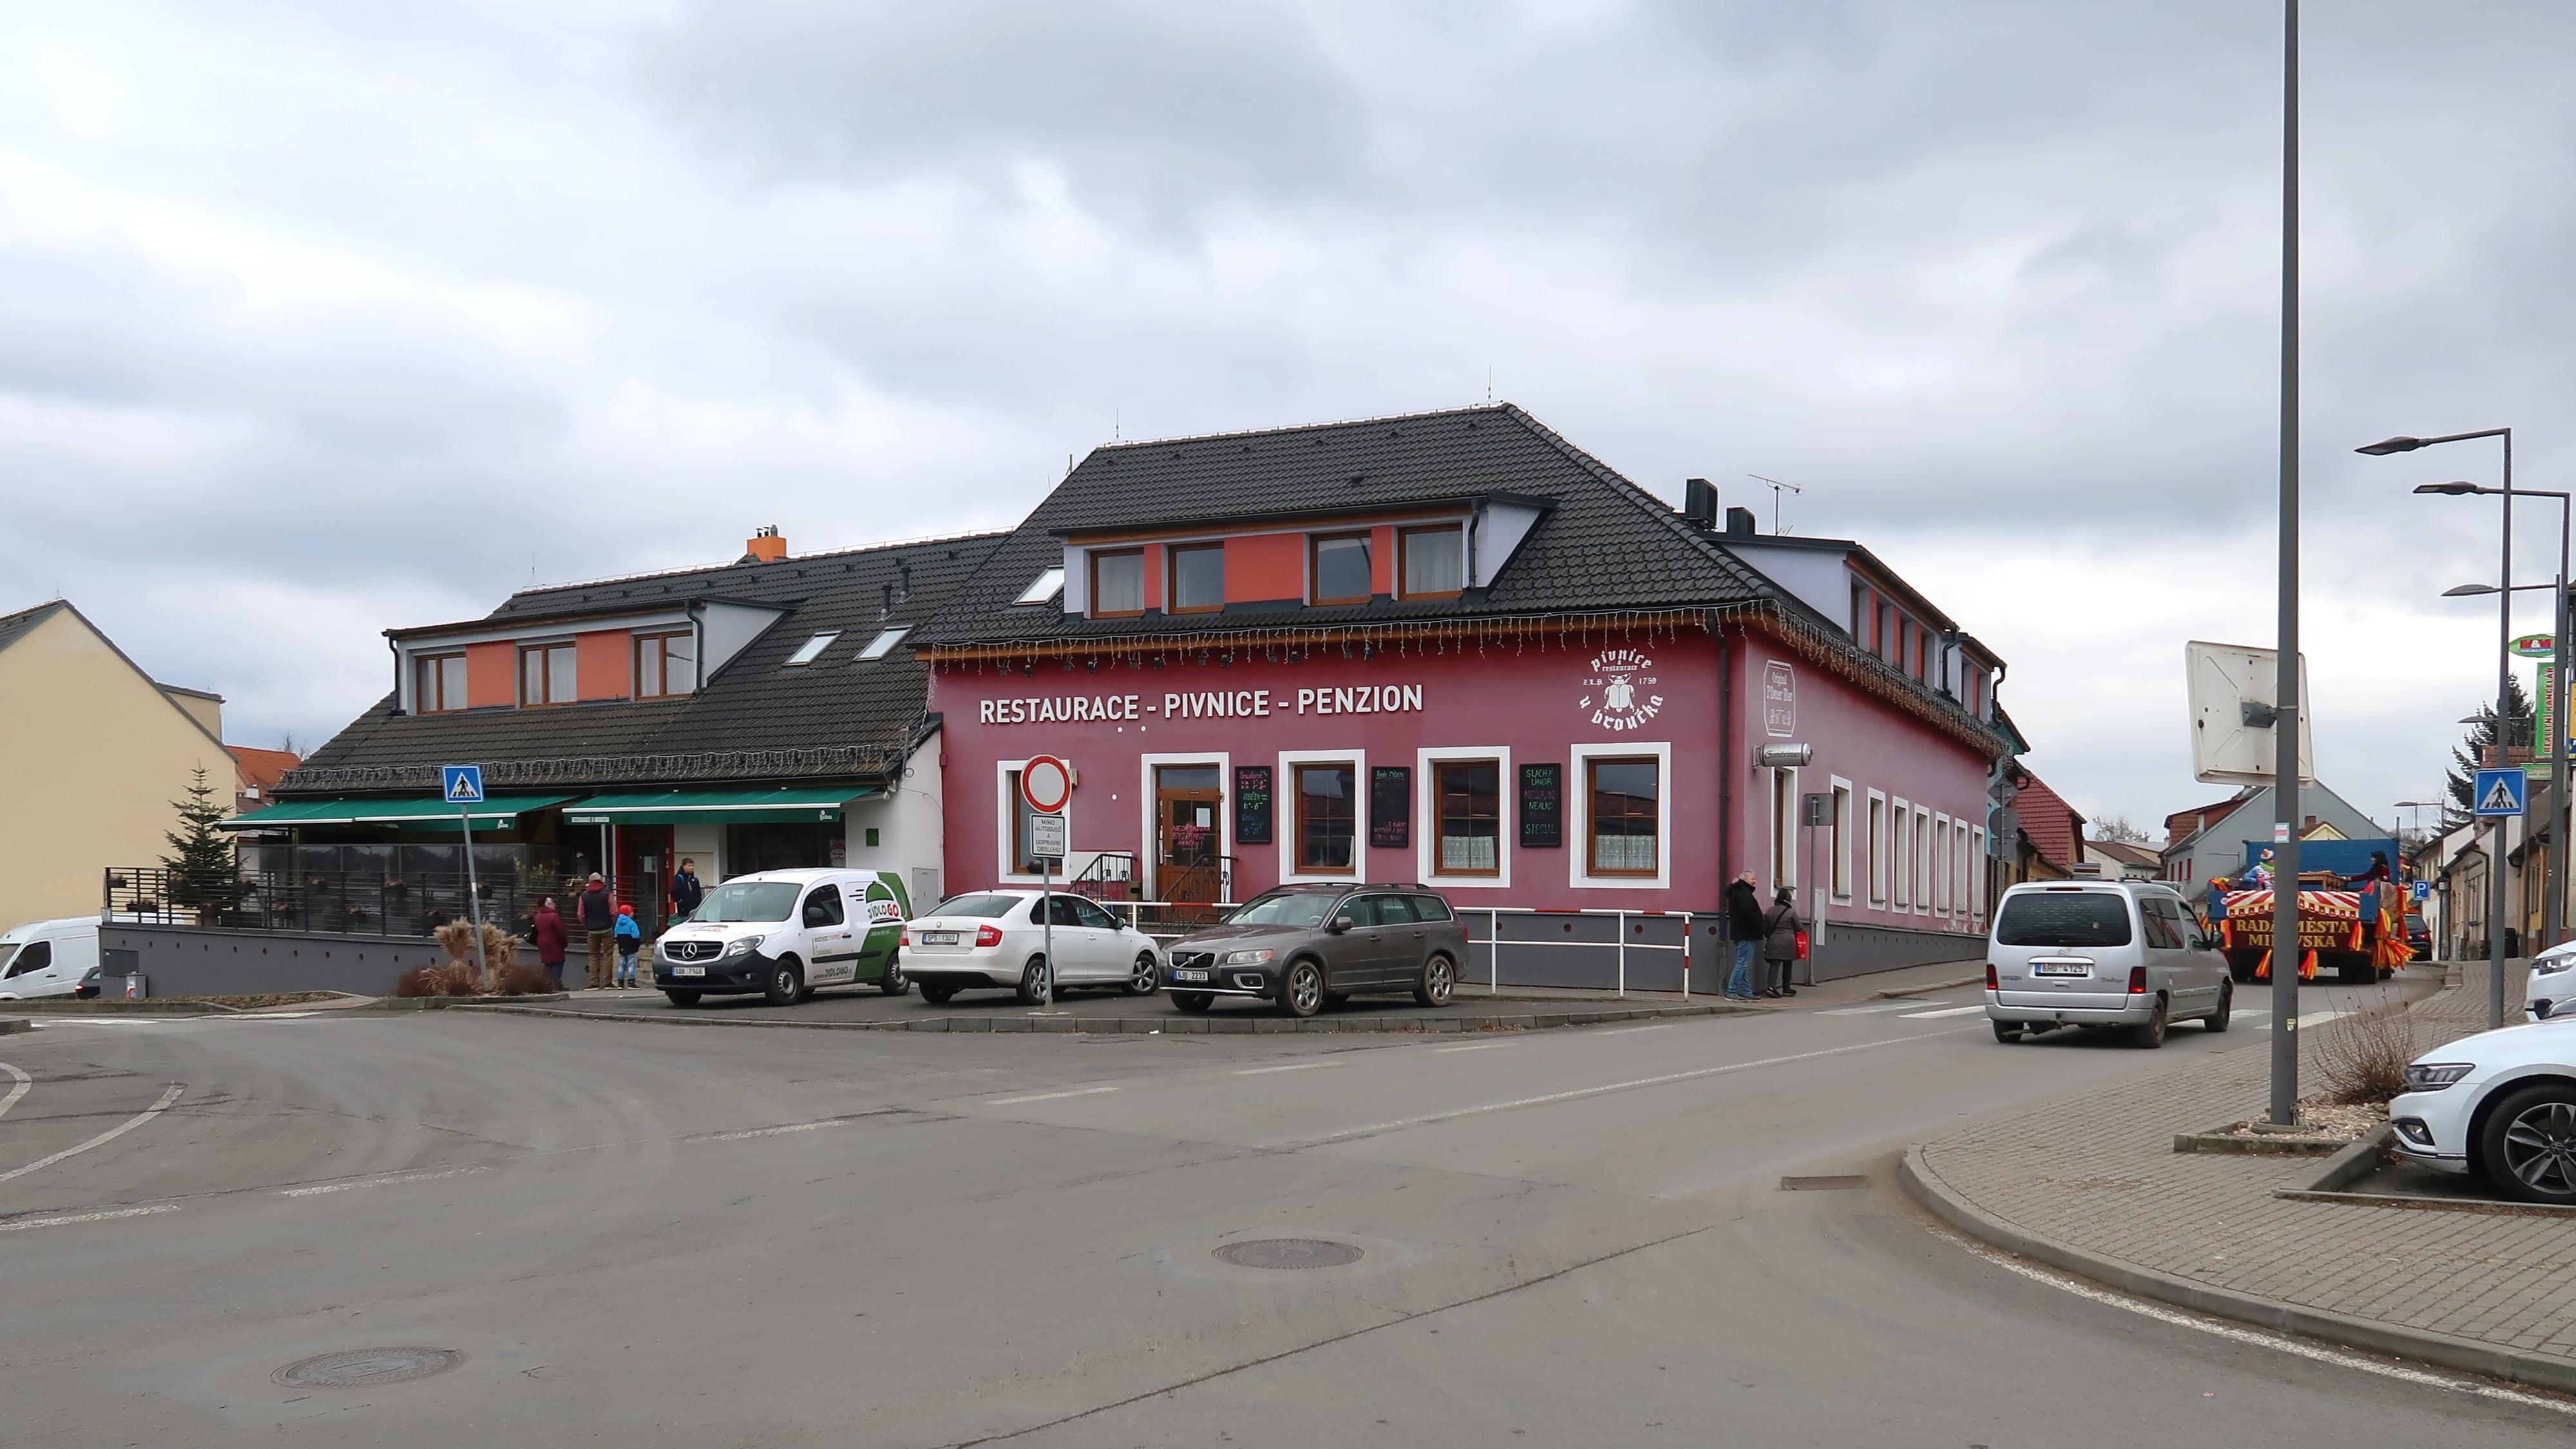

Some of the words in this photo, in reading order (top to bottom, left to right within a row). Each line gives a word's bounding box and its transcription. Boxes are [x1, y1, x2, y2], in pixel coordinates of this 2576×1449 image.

[1591, 648, 1653, 672] pivnice
[980, 695, 1139, 724] RESTAURACE
[1164, 690, 1270, 719] PIVNICE
[1298, 684, 1423, 715] PENZION
[1580, 695, 1591, 709] u
[1591, 695, 1663, 732] broučka
[2416, 883, 2426, 895] P
